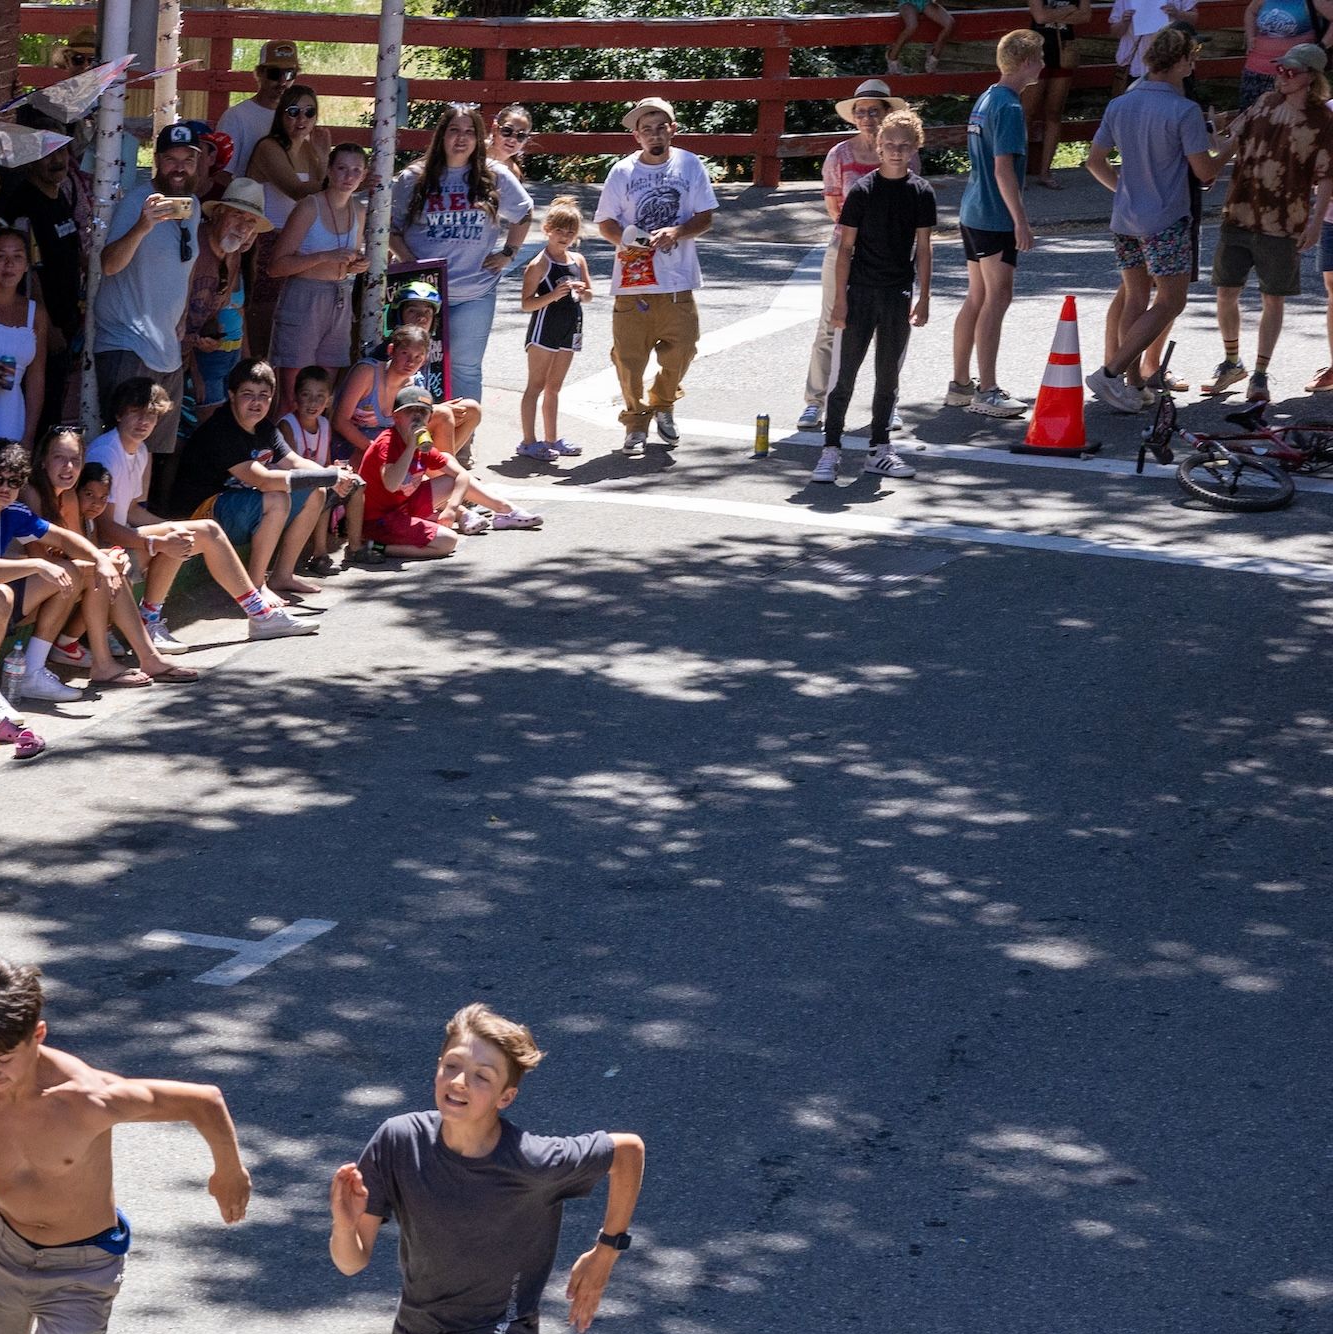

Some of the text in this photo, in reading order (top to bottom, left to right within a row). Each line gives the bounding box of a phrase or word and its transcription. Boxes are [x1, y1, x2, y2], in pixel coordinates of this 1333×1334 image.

[426, 210, 486, 226] WHITE
[427, 226, 483, 240] & BLUE
